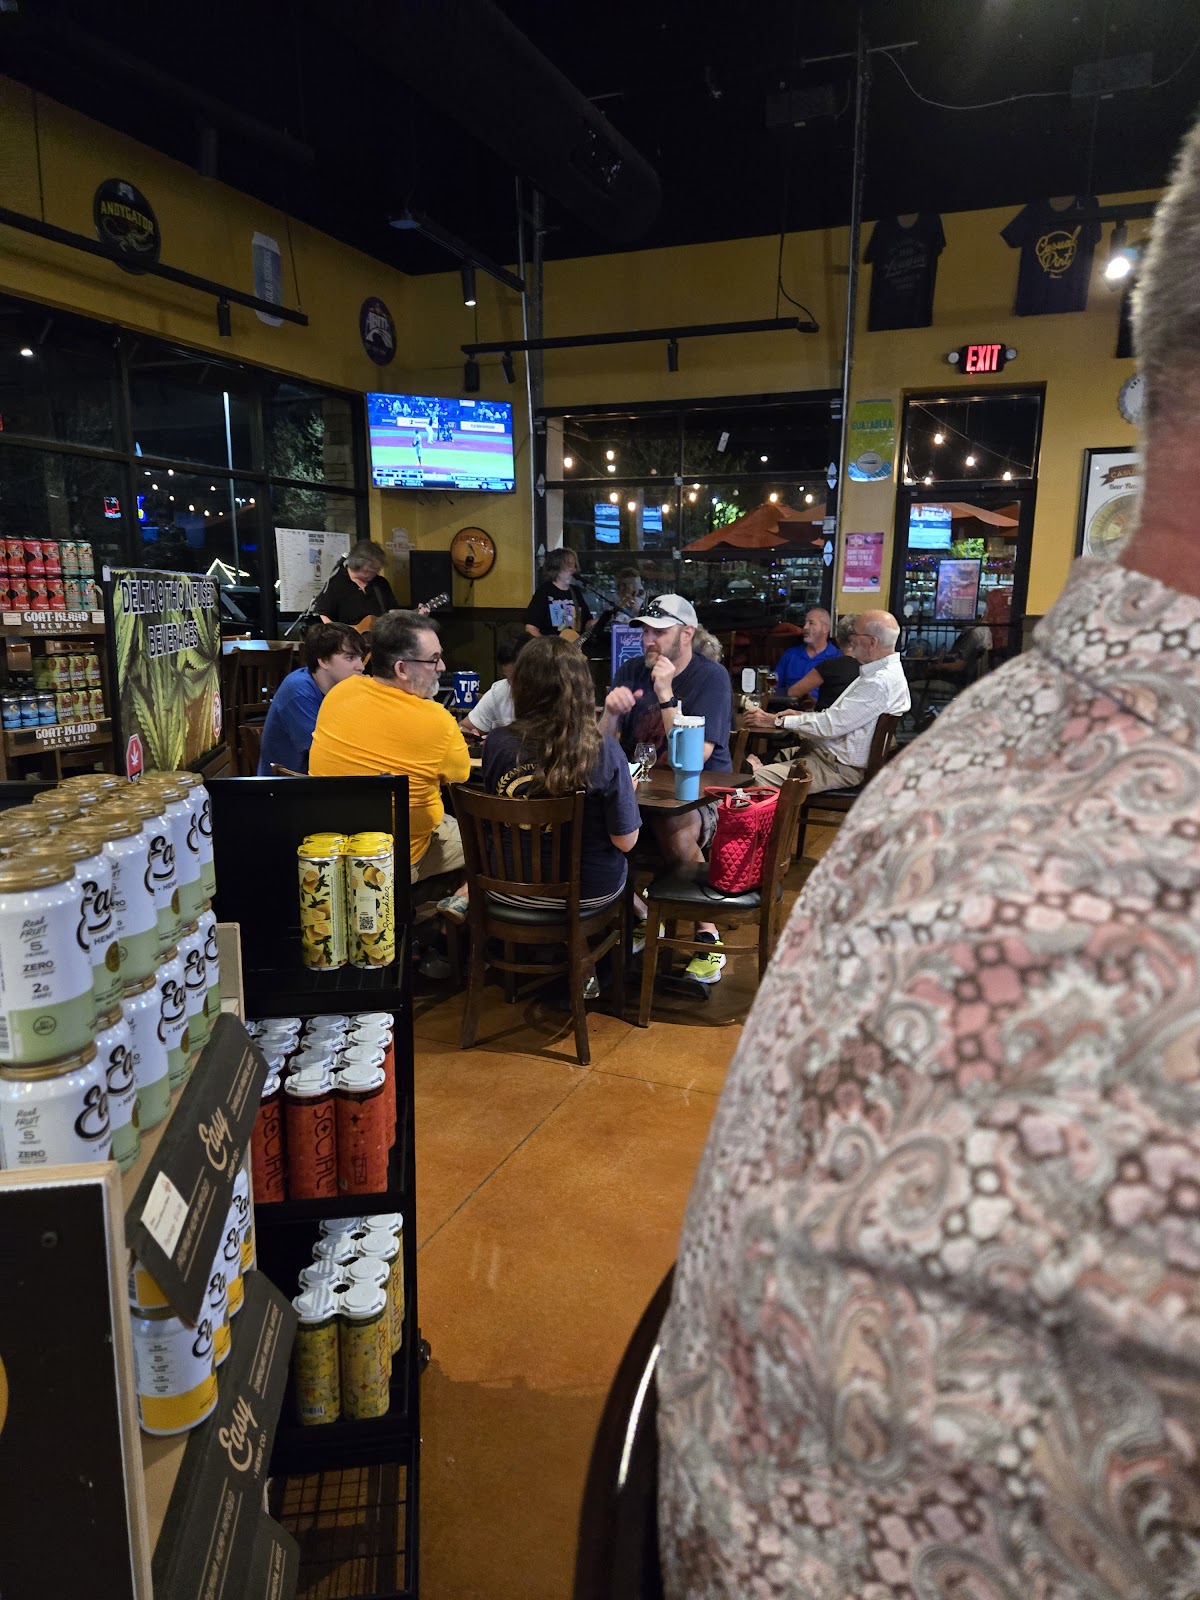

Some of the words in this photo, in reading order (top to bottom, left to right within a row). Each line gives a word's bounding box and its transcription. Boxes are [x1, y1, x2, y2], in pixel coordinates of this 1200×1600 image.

[100, 199, 155, 236] ANDYGATOR
[1035, 225, 1082, 256] Casual
[1041, 246, 1074, 273] Pint
[966, 344, 1001, 371] EXIT
[1110, 466, 1137, 479] CASU
[120, 579, 158, 615] DELTA
[165, 580, 184, 612] THC
[184, 579, 215, 611] INFUSED
[147, 620, 199, 658] BEVERAGES
[43, 734, 90, 746] BREWING
[508, 763, 537, 778] ANNIV
[19, 924, 49, 939] FRUIT
[22, 915, 46, 929] Real
[30, 941, 43, 951] 5
[23, 960, 55, 973] ZERO
[14, 1115, 41, 1128] FRUIT
[17, 1107, 37, 1118] Real
[24, 1130, 35, 1140] 5
[198, 1105, 234, 1172] Easy
[18, 1149, 46, 1158] ZERO
[261, 1105, 282, 1191] SOCIAL
[314, 1105, 335, 1190] SOCIAL
[219, 1395, 259, 1472] Easy
[253, 1446, 264, 1475] HEMP
[259, 1433, 267, 1448] CO
